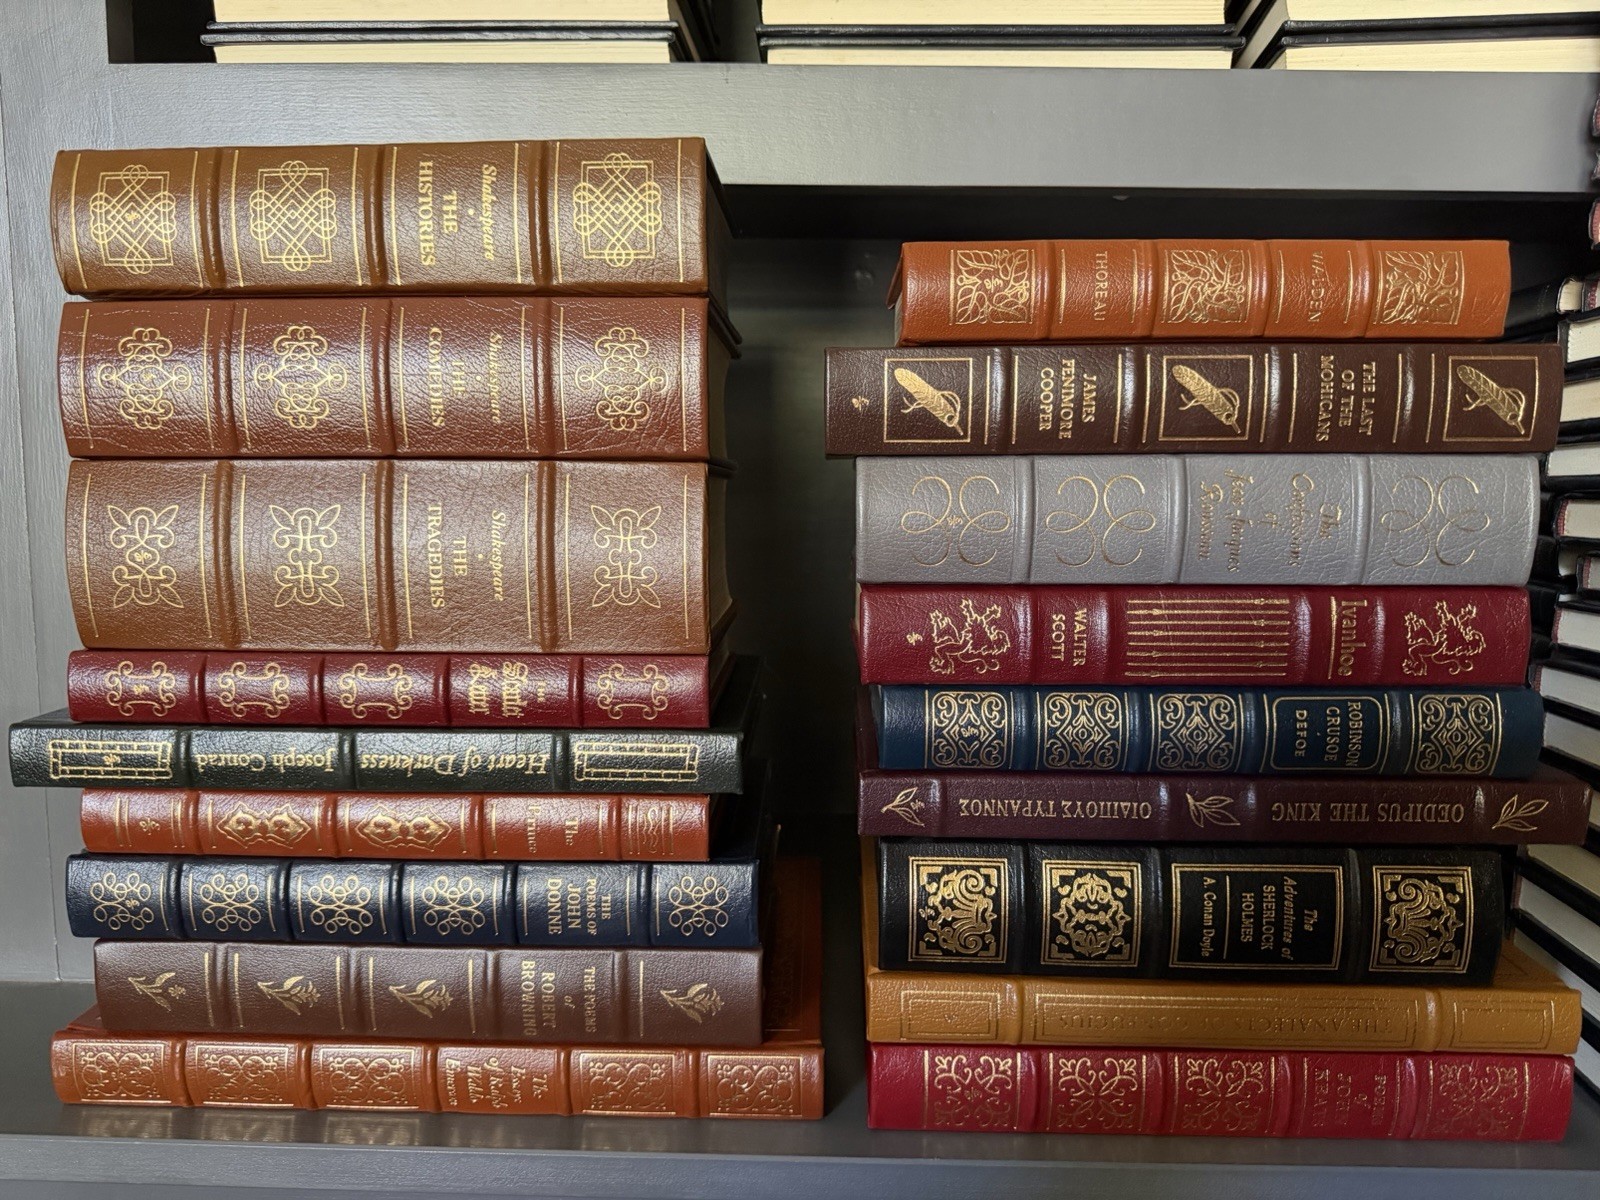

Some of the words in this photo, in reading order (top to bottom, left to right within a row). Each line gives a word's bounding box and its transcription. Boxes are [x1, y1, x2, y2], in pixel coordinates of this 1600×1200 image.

[418, 160, 436, 266] HISTORIES
[443, 190, 458, 233] THE
[480, 164, 497, 260] Shakespeare
[1094, 251, 1108, 321] THOREAU
[1309, 251, 1324, 322] WALDEN
[429, 327, 445, 427] COMEDIES
[452, 360, 466, 397] THE
[488, 330, 502, 424] Shakespeare
[1081, 373, 1097, 422] JAMES
[1315, 355, 1334, 442] MOHICANS
[1341, 369, 1355, 391] OF
[1362, 362, 1376, 393] THE
[1039, 367, 1054, 431] COOPER
[1058, 359, 1075, 440] FENIMORE
[1338, 395, 1354, 427] THE
[1358, 398, 1374, 436] LAST
[1285, 472, 1315, 568] Confessions
[1319, 503, 1342, 539] The
[428, 502, 445, 608] TRAGEDIES
[453, 536, 468, 576] THE
[490, 510, 507, 601] Shakespeare
[1051, 613, 1066, 662] SCOTT
[1073, 608, 1087, 667] WALTER
[1337, 600, 1368, 677] Ivanhoe
[466, 663, 498, 715] Letter
[501, 661, 529, 718] Scarlet
[537, 680, 547, 704] THE
[1294, 709, 1309, 757] DEFOE
[1324, 706, 1341, 762] CRUSOE
[1345, 701, 1363, 767] ROBINSON
[194, 753, 267, 773] Conrad
[271, 746, 337, 774] Joseph
[359, 754, 457, 778] Darkness
[457, 746, 481, 777] of
[489, 753, 551, 775] Heart
[527, 805, 542, 854] Prince
[565, 816, 579, 847] The
[1271, 802, 1322, 821] KING
[1329, 802, 1369, 821] THE
[1377, 802, 1465, 823] OEDIPUS
[586, 877, 597, 919] POEMS
[1202, 876, 1217, 889] A.
[547, 877, 563, 935] DONNE
[567, 883, 582, 929] JOHN
[601, 893, 611, 920] THE
[1203, 891, 1217, 927] Conan
[1240, 892, 1255, 943] HOLMES
[1261, 884, 1276, 951] SHERLOCK
[1283, 875, 1298, 944] Adventures
[1304, 909, 1318, 932] The
[587, 921, 598, 936] OF
[1200, 928, 1216, 958] Doyle
[1281, 947, 1294, 960] of
[521, 960, 537, 1036] BROWNING
[541, 971, 557, 1029] ROBERT
[583, 966, 596, 991] THE
[563, 995, 576, 1009] of
[584, 994, 598, 1033] POEMS
[532, 1073, 549, 1098] The
